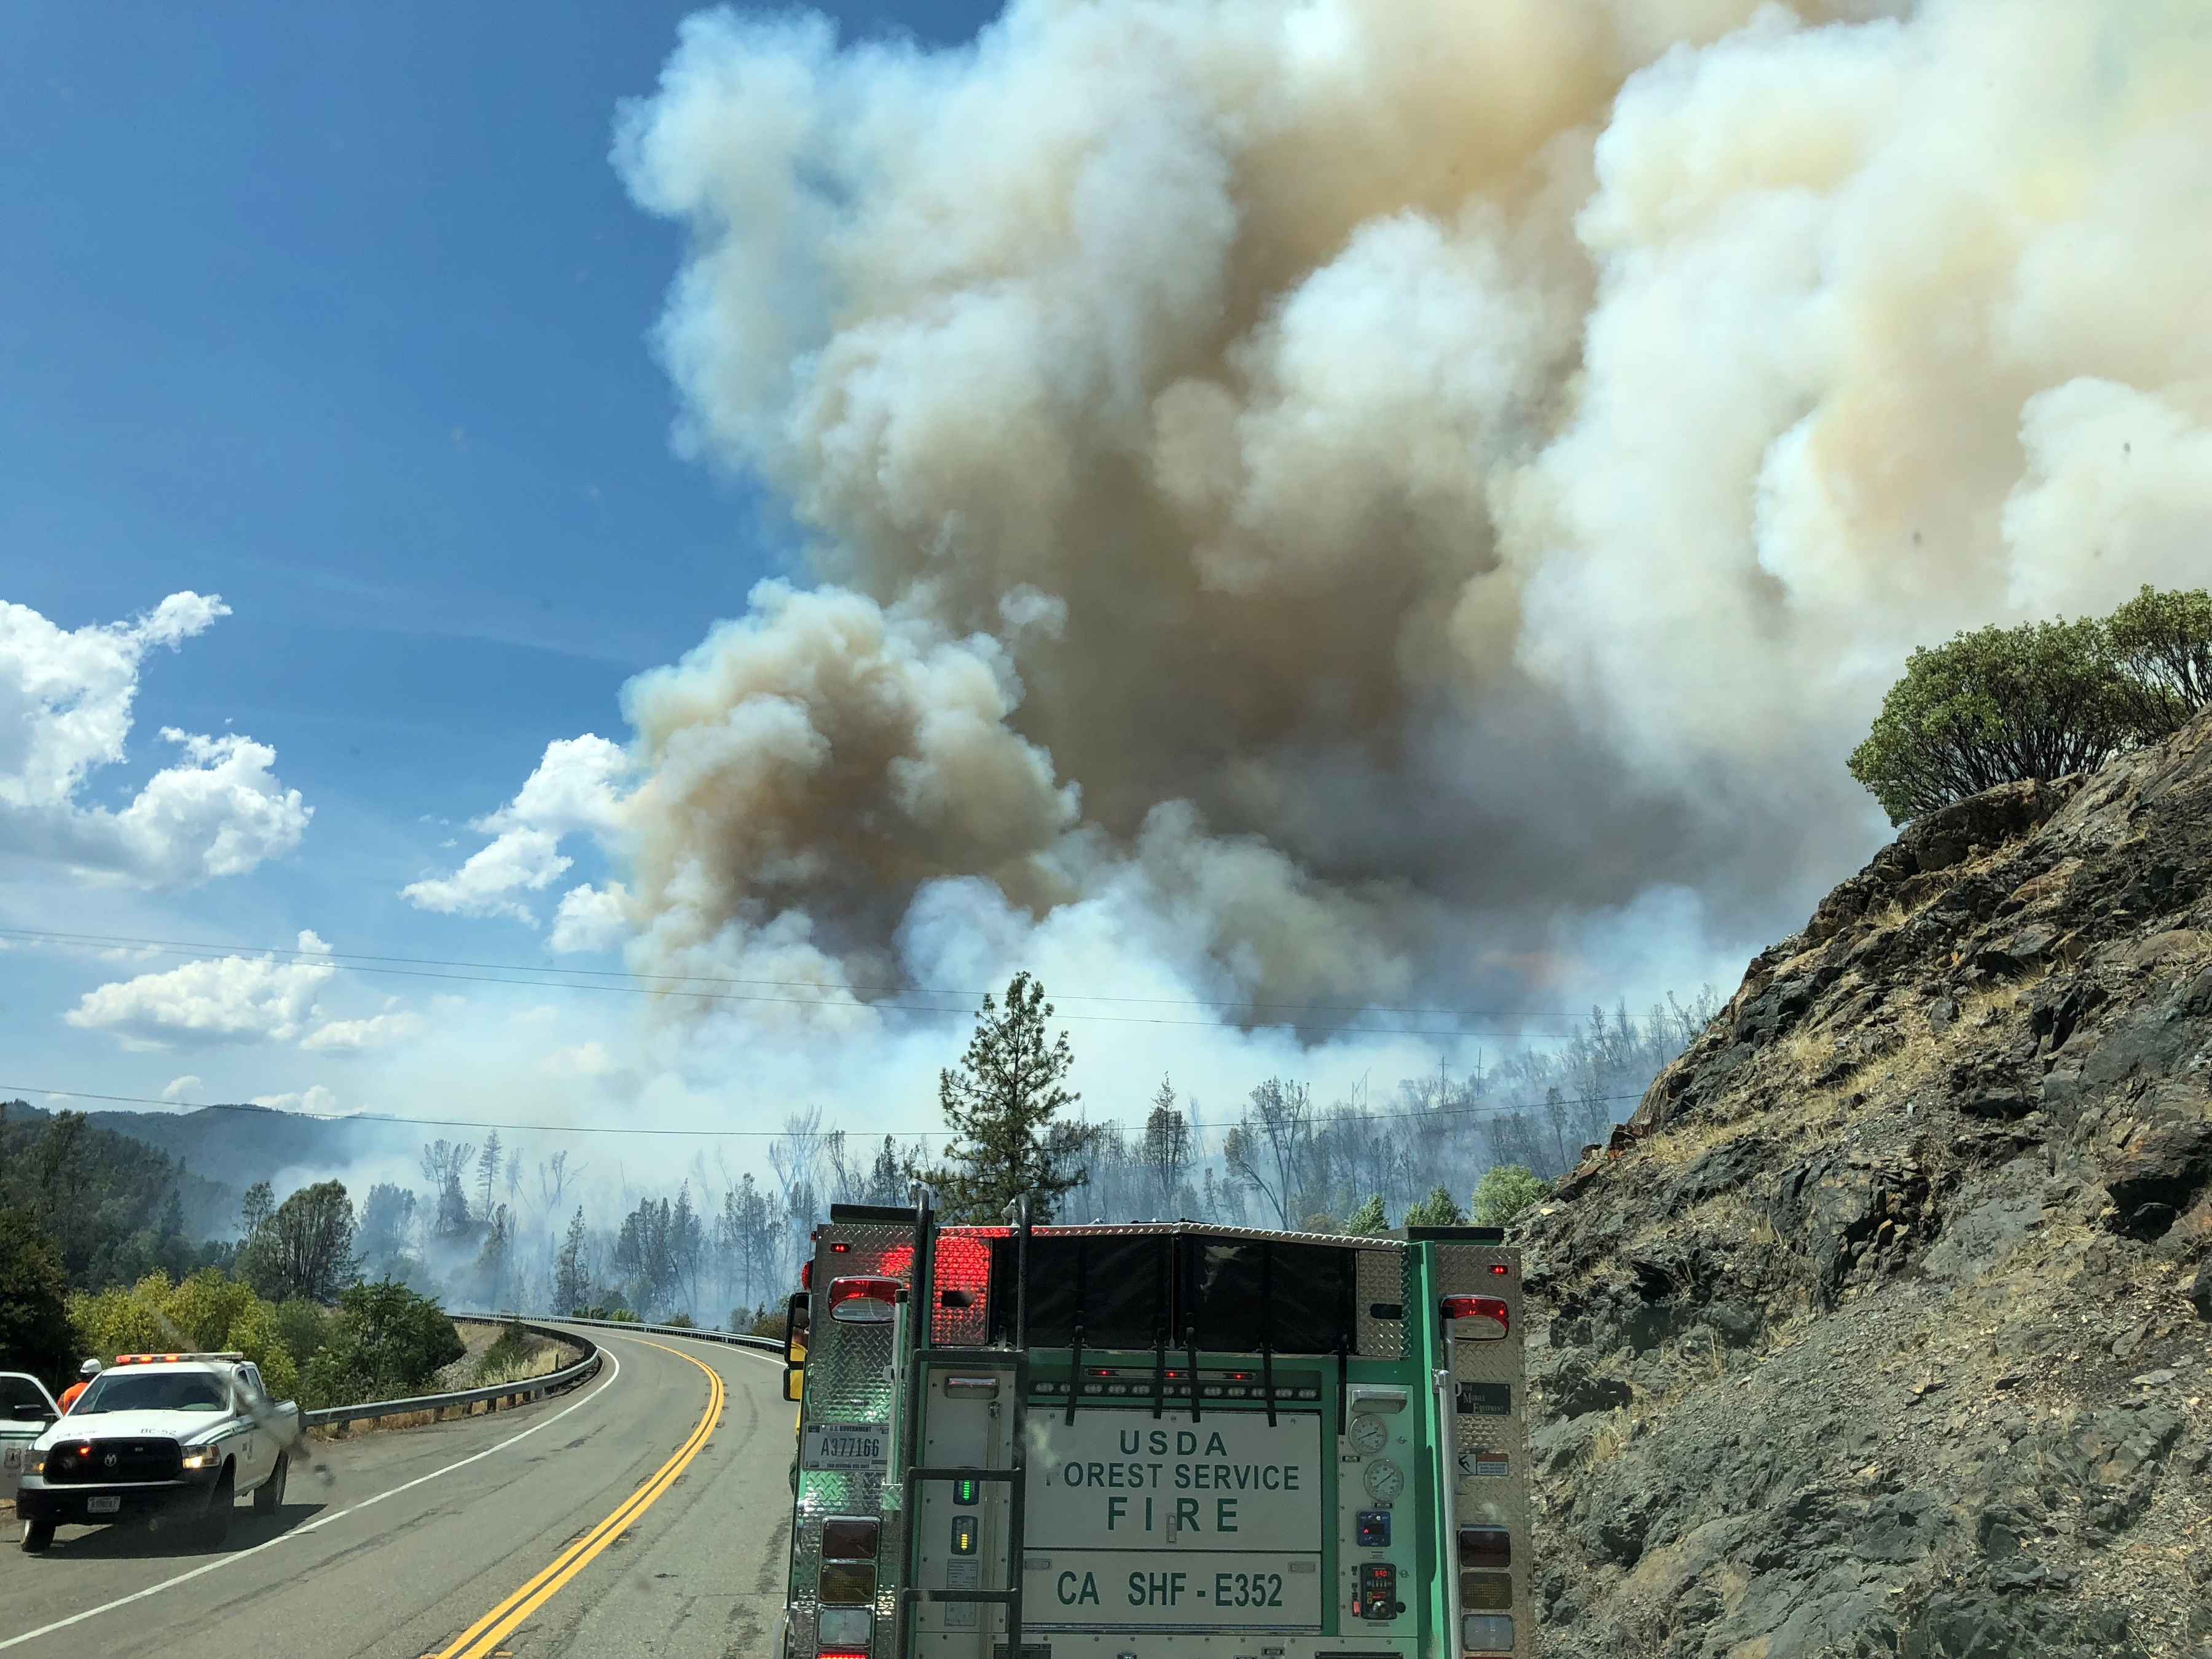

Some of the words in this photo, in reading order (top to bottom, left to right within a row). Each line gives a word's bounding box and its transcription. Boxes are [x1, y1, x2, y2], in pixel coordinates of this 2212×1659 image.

[820, 1438, 880, 1456] A377166
[1120, 1430, 1228, 1456] USDA
[1174, 1464, 1300, 1490] SERVICE
[1108, 1497, 1239, 1532] FIRE
[1057, 1571, 1100, 1606] CA
